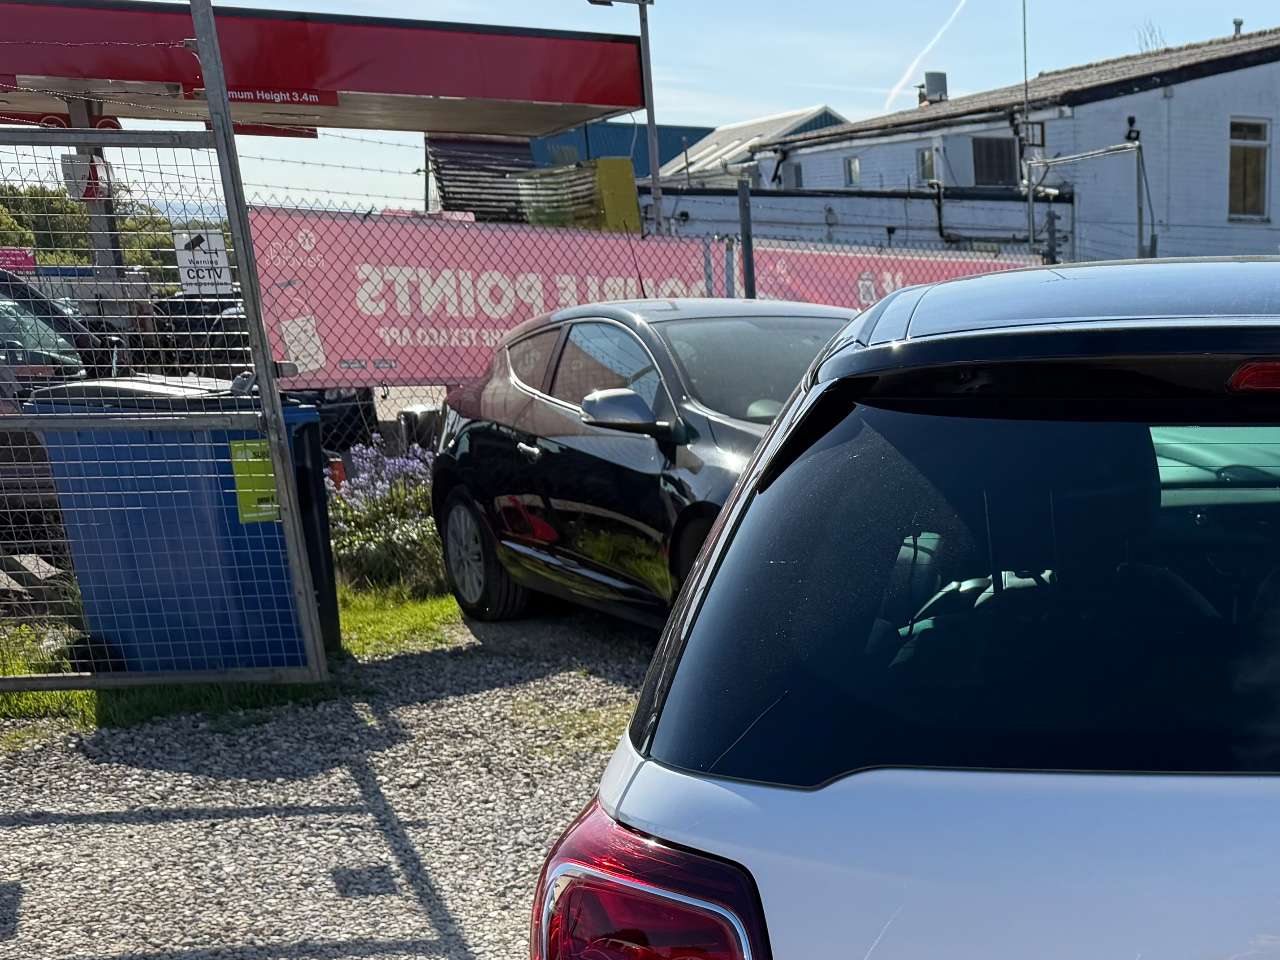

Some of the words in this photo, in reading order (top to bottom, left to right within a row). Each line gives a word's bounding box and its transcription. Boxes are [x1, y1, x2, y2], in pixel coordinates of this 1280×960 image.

[256, 90, 290, 103] Height
[293, 92, 319, 102] 3.4m
[186, 268, 223, 280] CCTV
